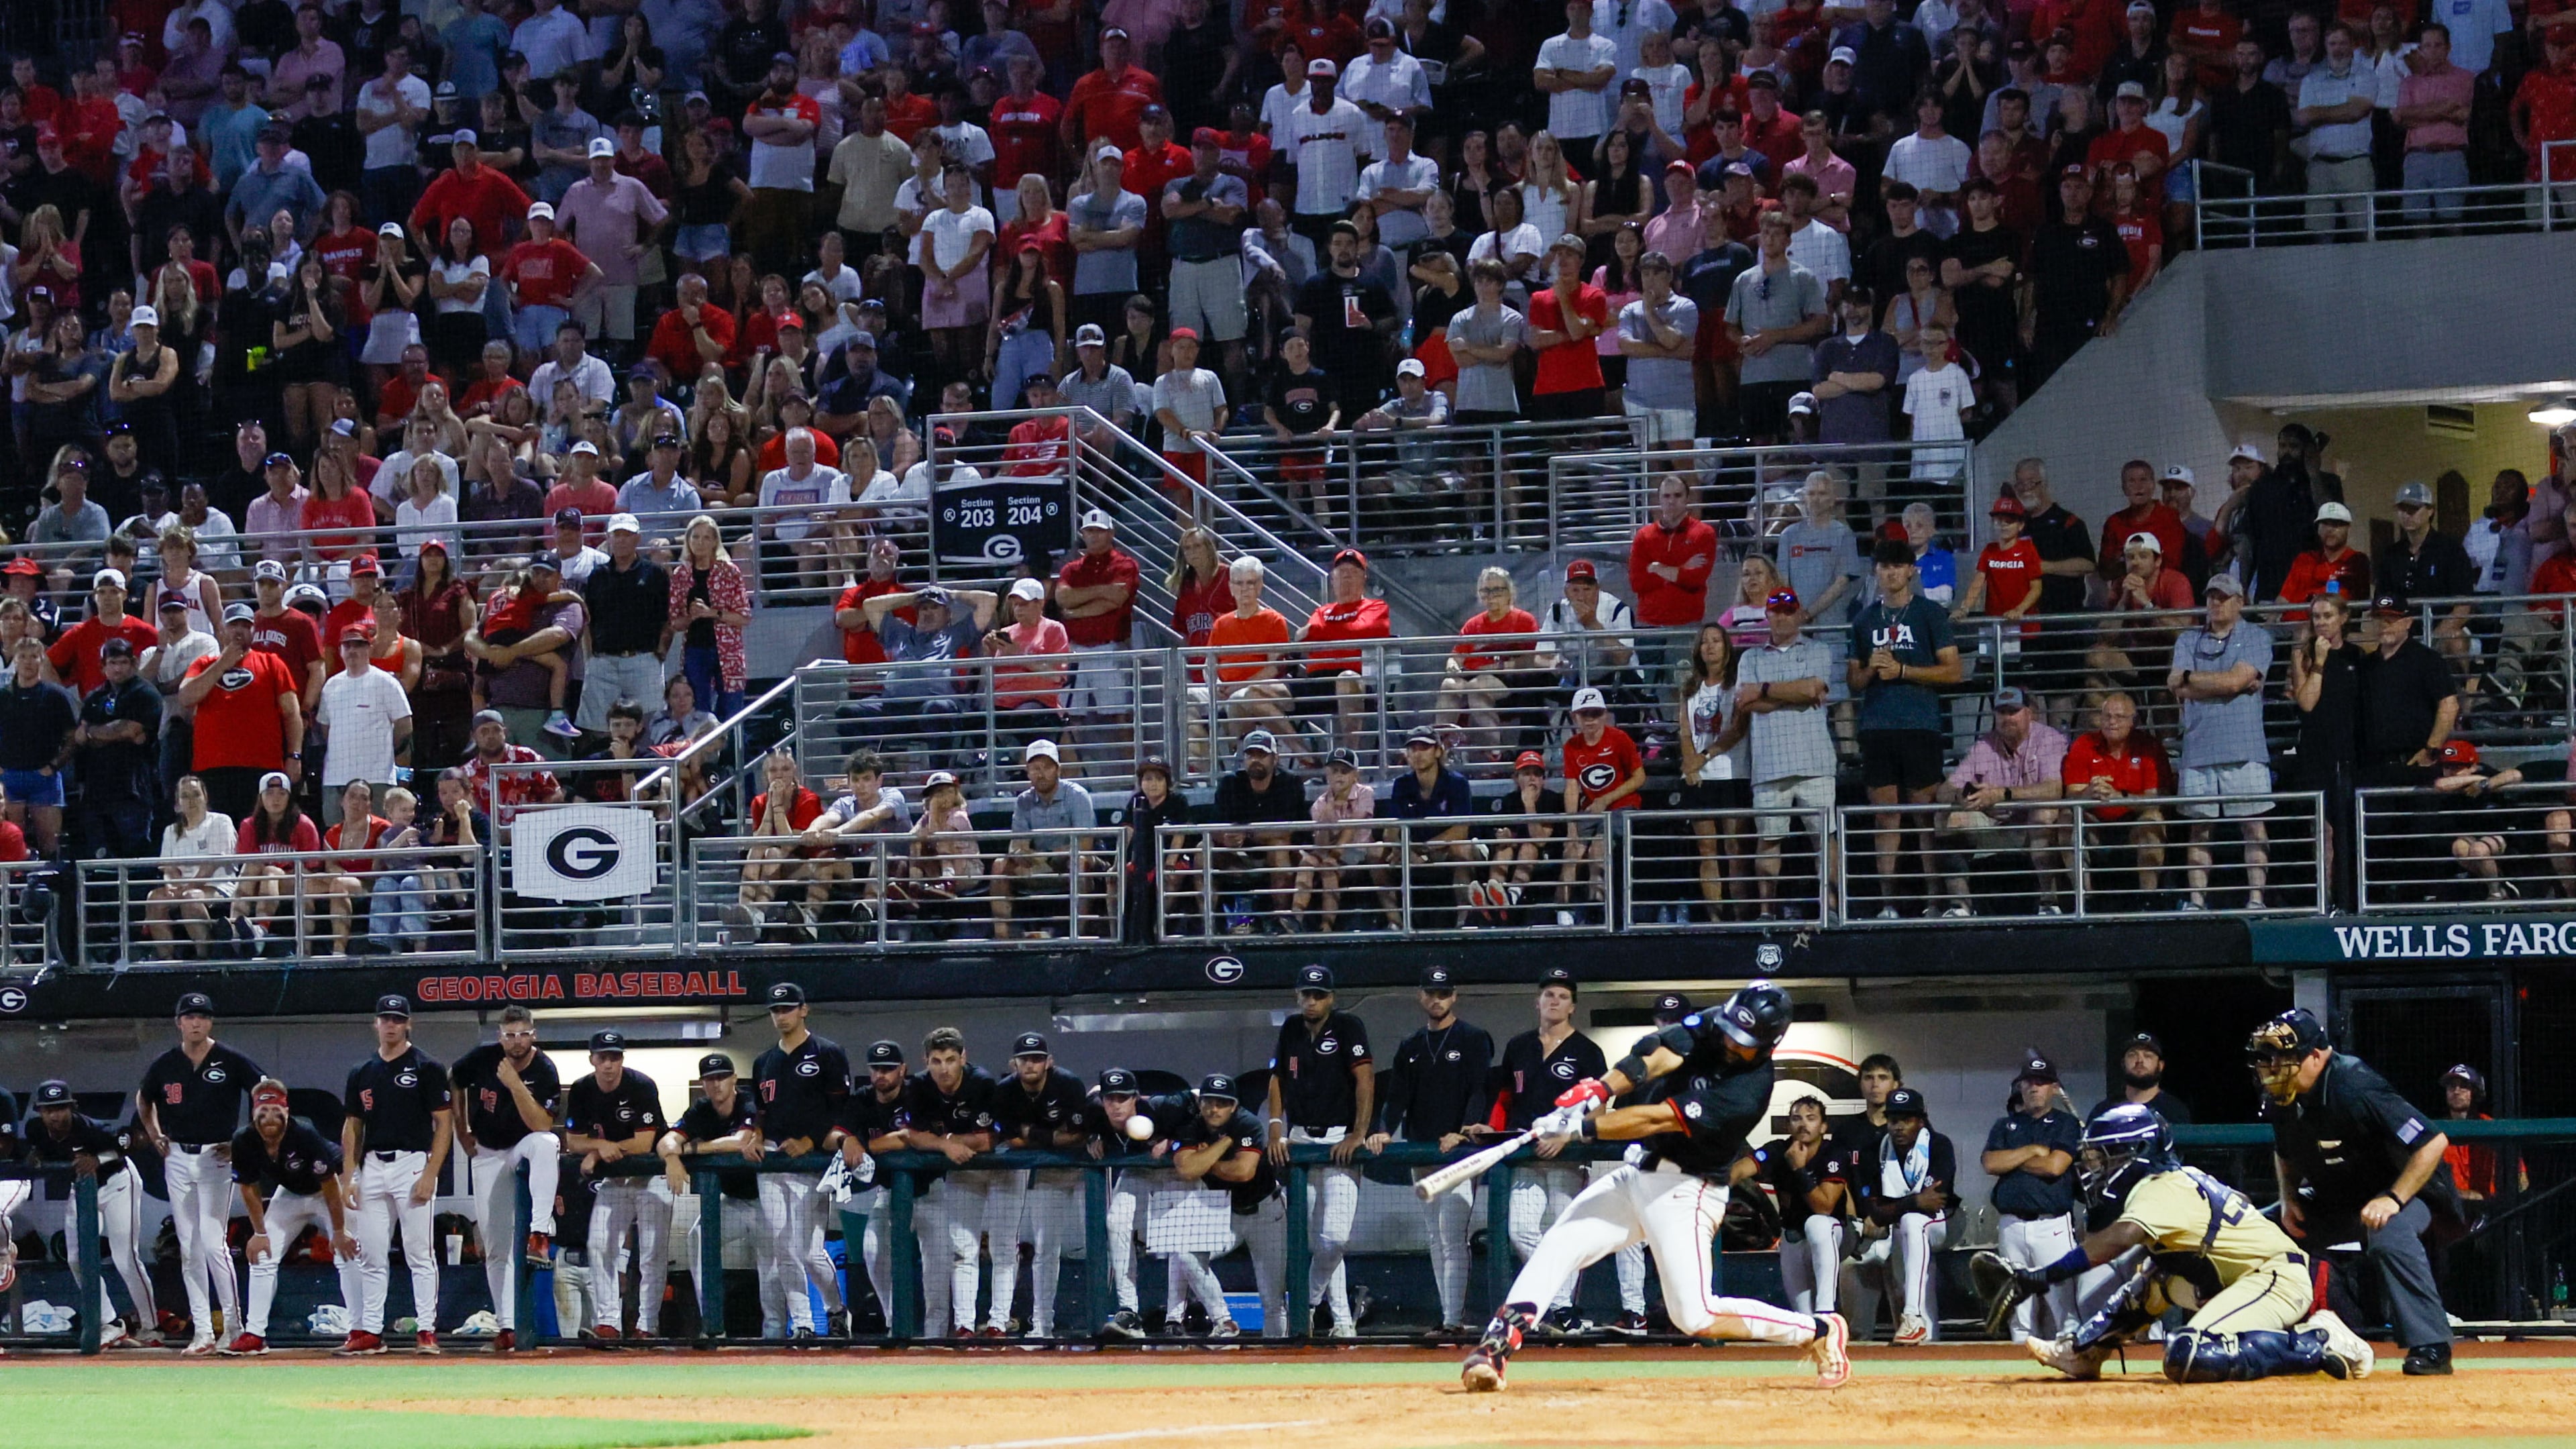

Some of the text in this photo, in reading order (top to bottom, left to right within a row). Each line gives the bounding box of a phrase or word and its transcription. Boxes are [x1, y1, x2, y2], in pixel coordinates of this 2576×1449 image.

[1293, 398, 1313, 413] G
[961, 495, 1040, 508] Section Section
[961, 505, 1042, 528] 203 204
[2377, 596, 2394, 607] G
[252, 629, 288, 647] LLDOGS
[1872, 623, 1915, 646] UA
[216, 667, 254, 692] G
[780, 718, 794, 733] G
[1578, 763, 1616, 792] G
[545, 827, 620, 879] G
[2334, 923, 2471, 958] WELLS
[1205, 955, 1244, 983] G
[1305, 970, 1324, 982] G
[1429, 969, 1448, 982] G
[1549, 968, 1568, 980] G
[417, 971, 747, 1002] GEORGIA BASEBALL
[772, 988, 788, 999] G
[0, 987, 27, 1012] G
[190, 994, 206, 1006] G
[385, 998, 402, 1010] G
[1660, 996, 1680, 1009] G
[600, 1031, 619, 1043] G
[1025, 1036, 1041, 1047] G
[875, 1046, 891, 1058] G
[1316, 1038, 1339, 1055] G
[707, 1056, 723, 1067] G
[1444, 1049, 1462, 1062] G
[202, 1069, 227, 1083] G
[795, 1061, 820, 1077] G
[1550, 1062, 1576, 1080] G
[394, 1072, 419, 1087] G
[1109, 1073, 1125, 1085] G
[1210, 1077, 1228, 1089] G
[46, 1084, 63, 1099] G
[1891, 1091, 1910, 1104] G
[616, 1107, 635, 1122] G
